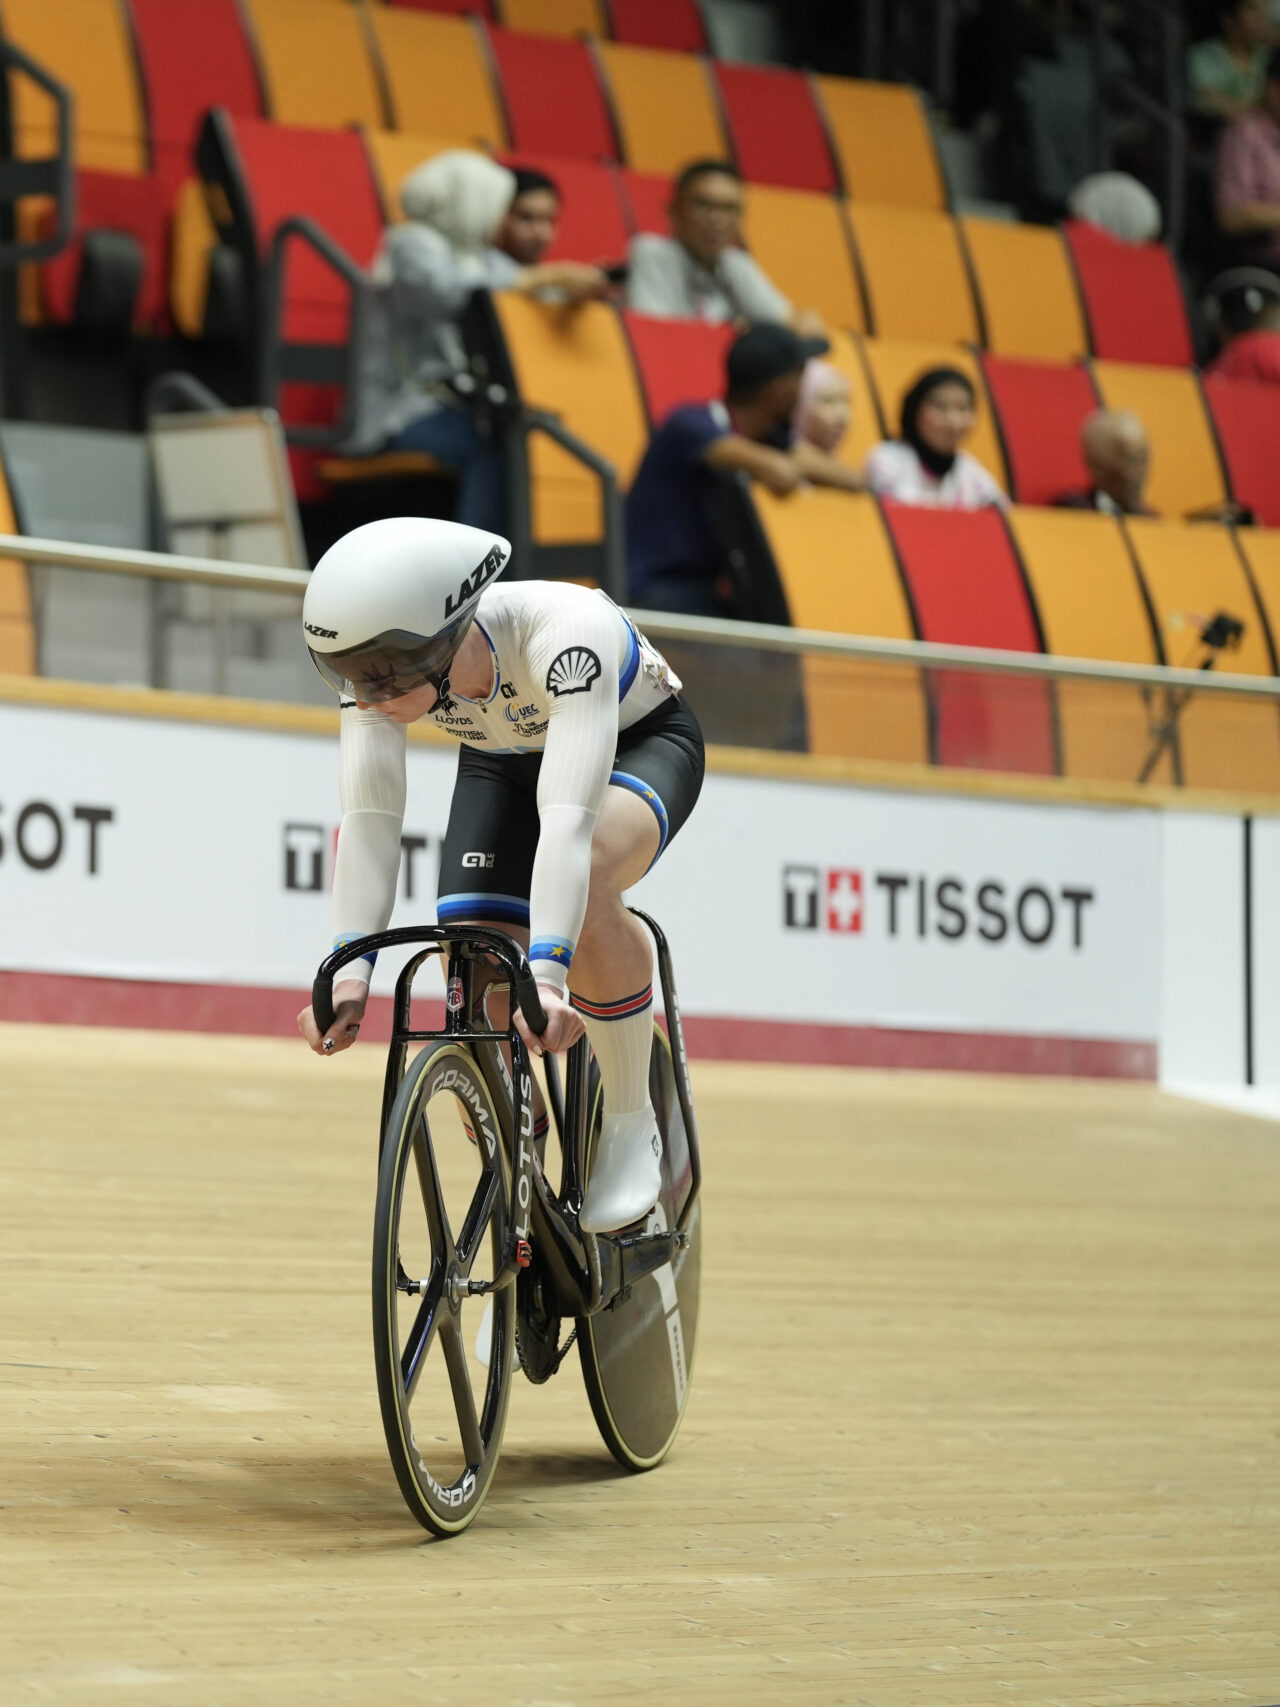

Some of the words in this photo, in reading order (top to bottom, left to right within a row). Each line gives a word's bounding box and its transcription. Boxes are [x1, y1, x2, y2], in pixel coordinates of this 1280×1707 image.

[444, 543, 507, 619] LAZER
[304, 621, 339, 639] LAZER
[435, 714, 474, 726] LLOYDS
[518, 703, 539, 718] UEC
[875, 873, 1094, 948] TISSOT
[431, 1069, 496, 1160] CORIMA
[515, 1073, 533, 1241] LOTUS
